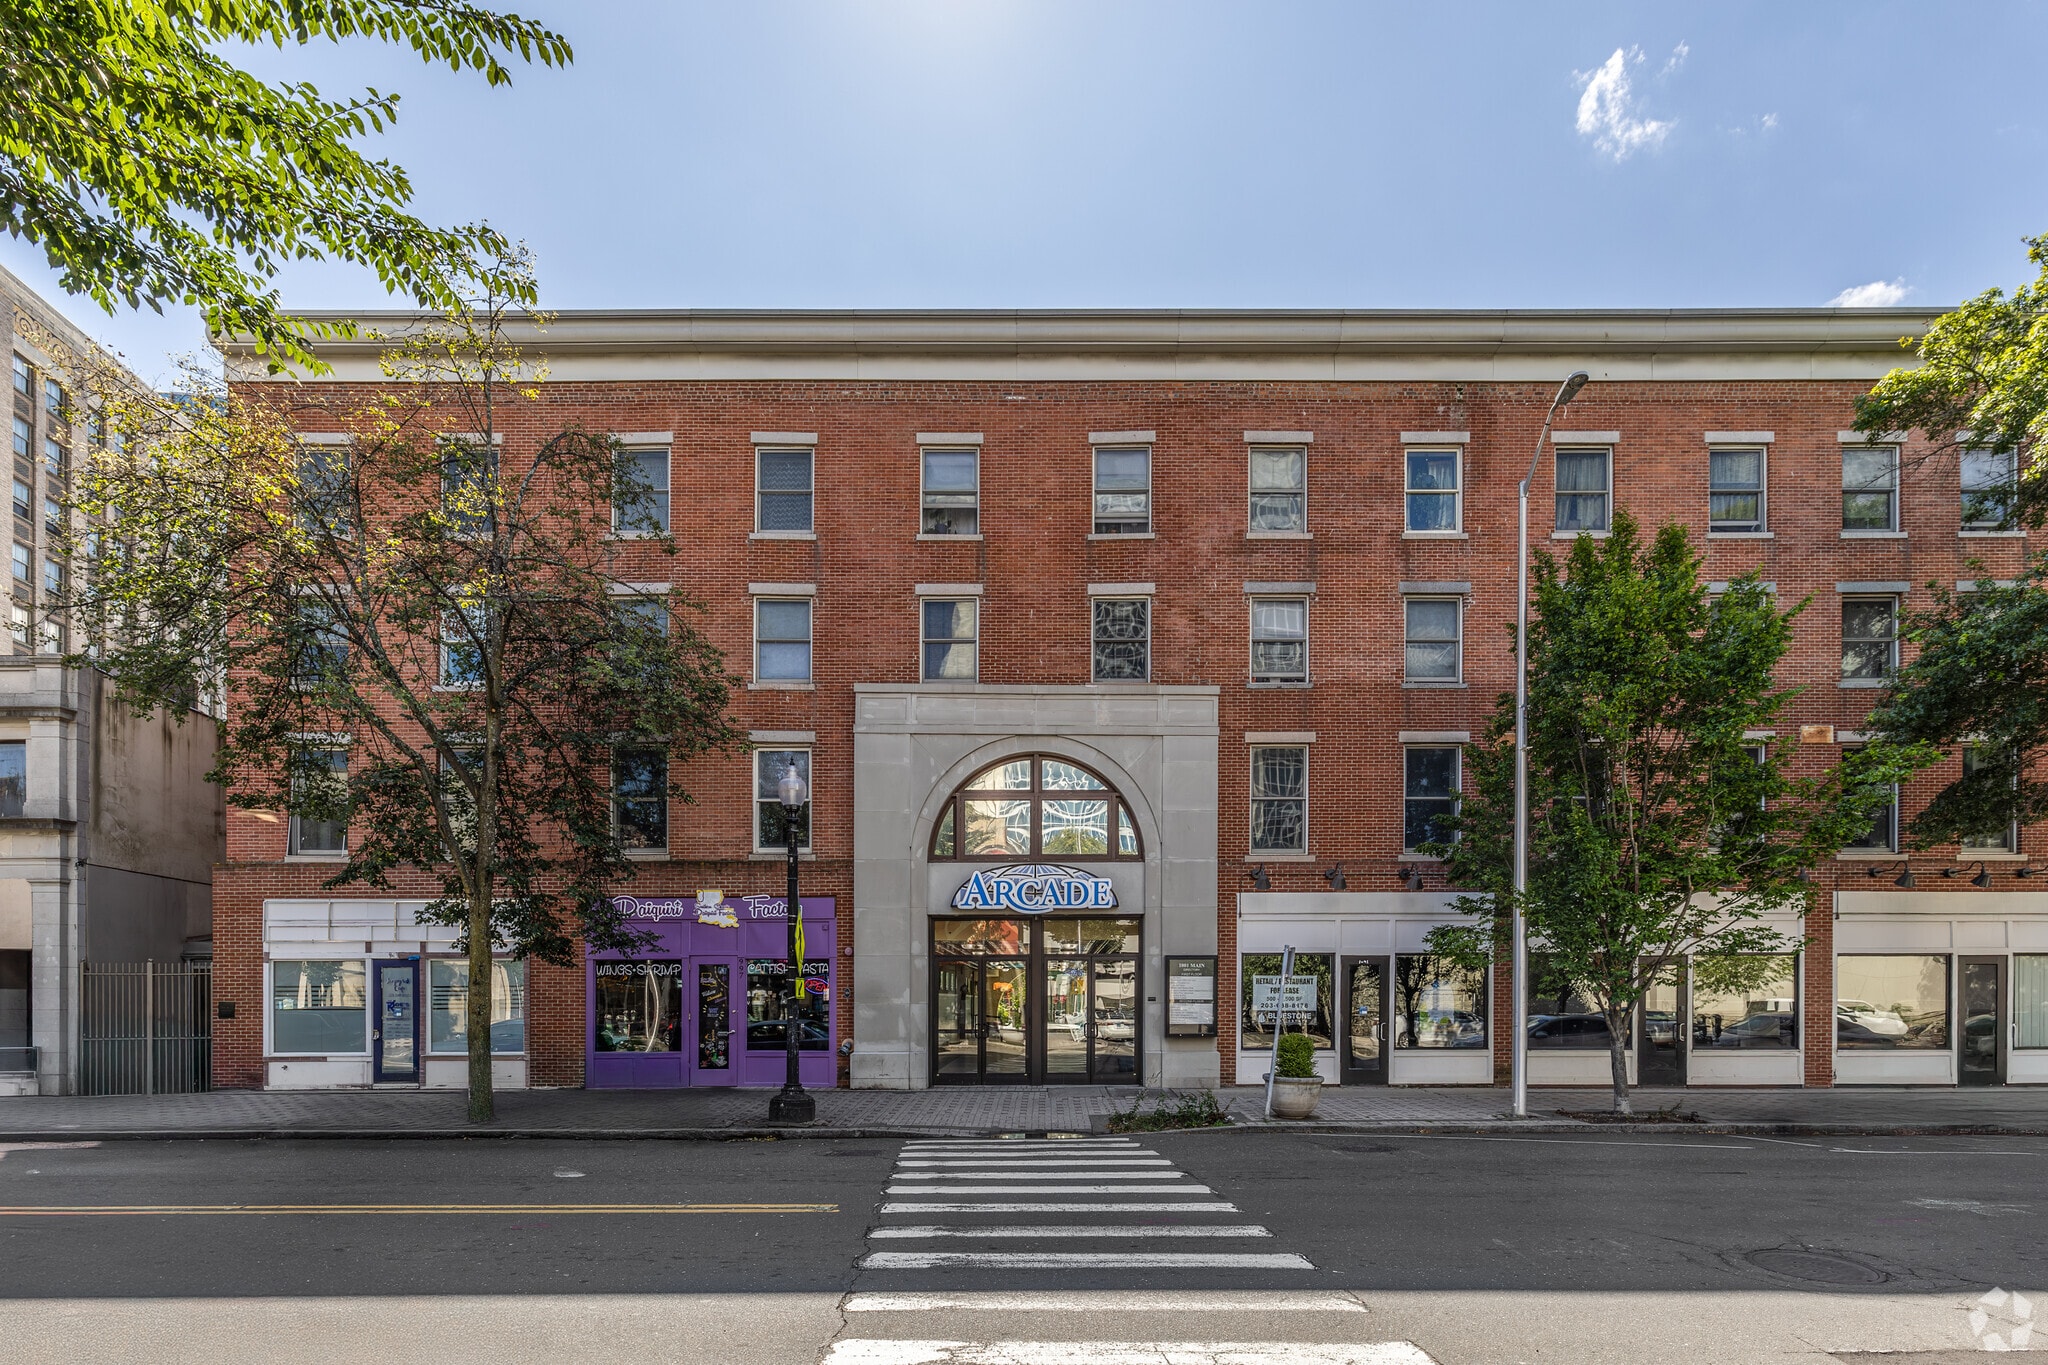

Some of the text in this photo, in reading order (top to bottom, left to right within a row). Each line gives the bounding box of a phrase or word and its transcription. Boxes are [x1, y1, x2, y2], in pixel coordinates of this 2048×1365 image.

[957, 870, 1113, 914] ARCADE
[612, 895, 684, 922] Daiquiri
[801, 962, 829, 975] ASTA
